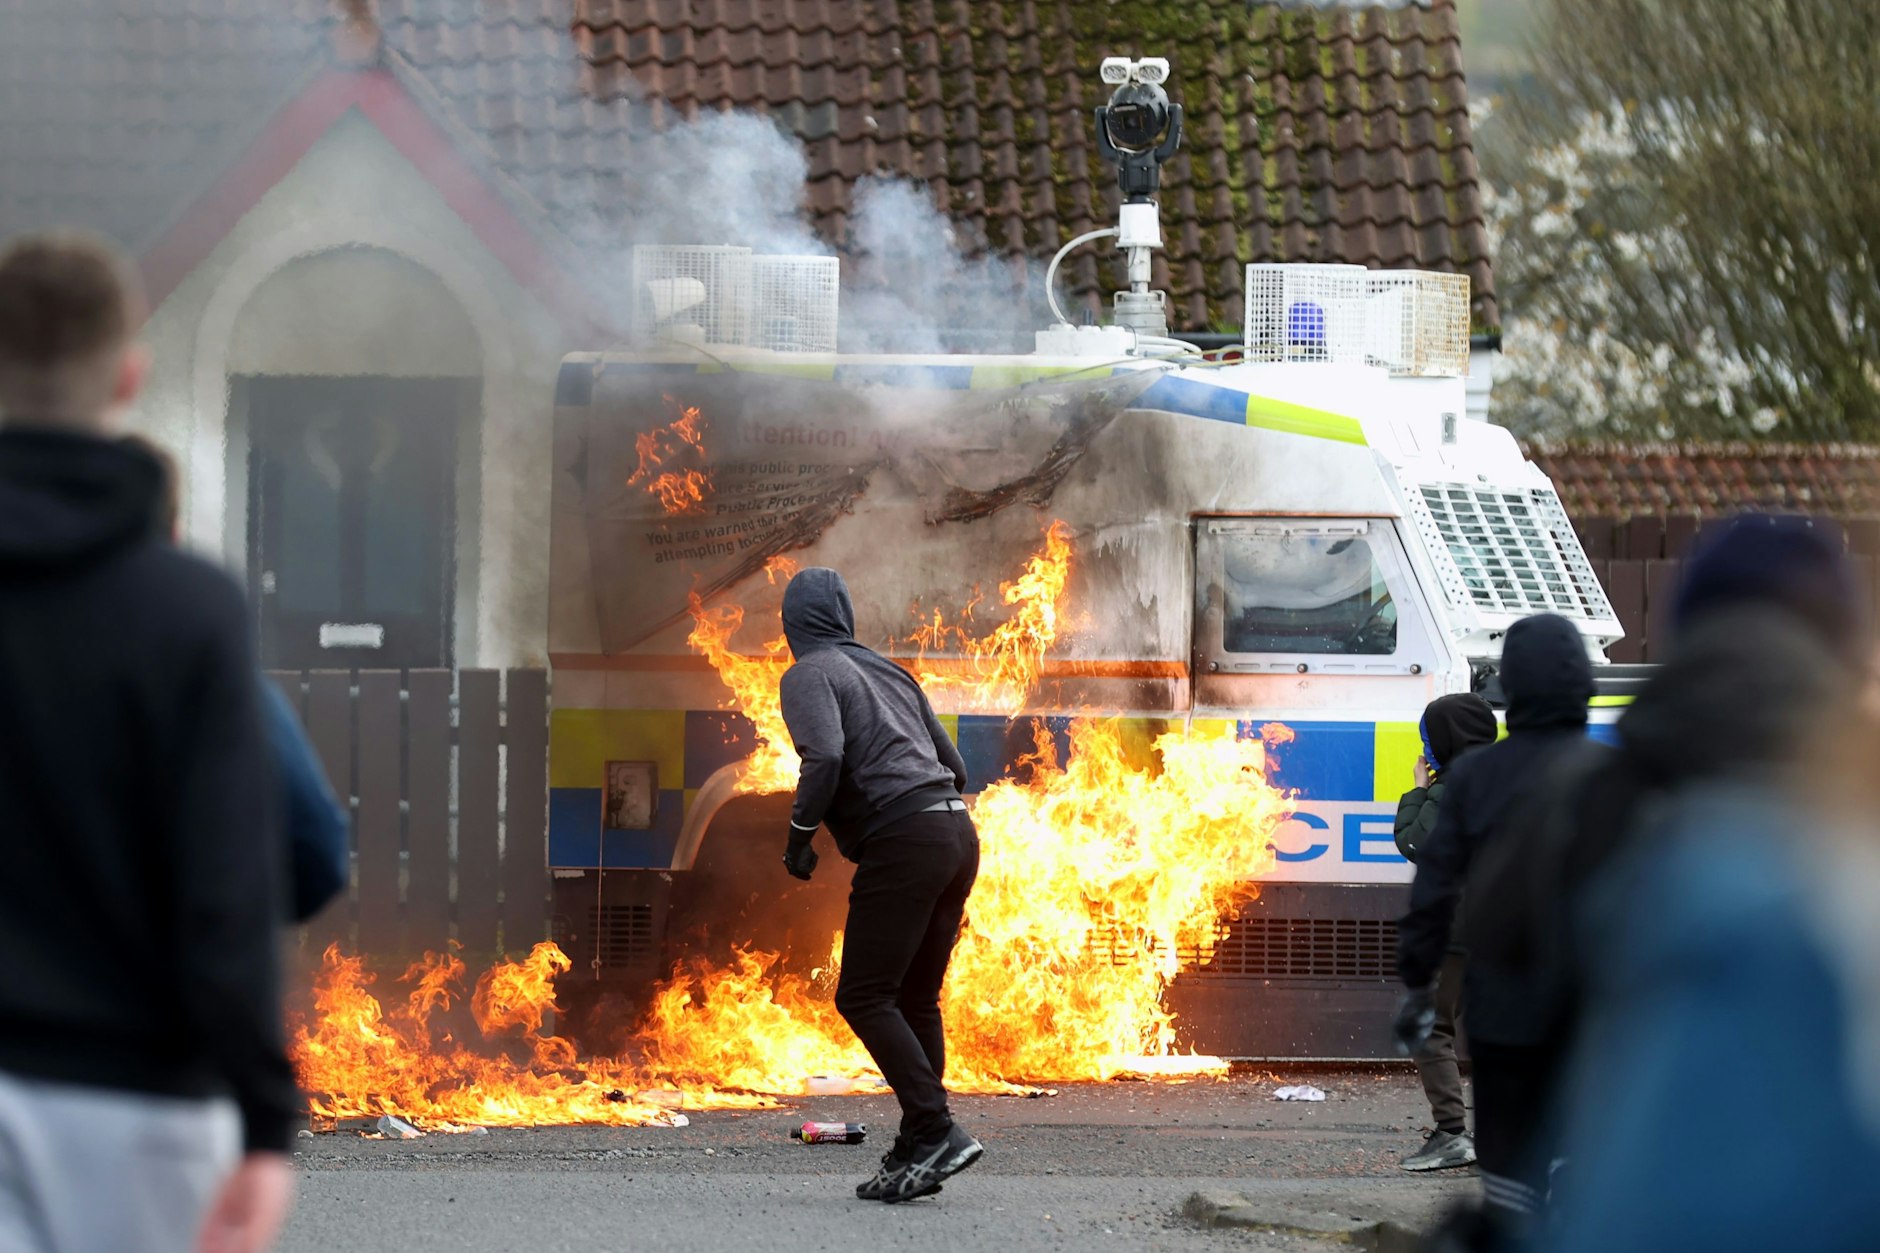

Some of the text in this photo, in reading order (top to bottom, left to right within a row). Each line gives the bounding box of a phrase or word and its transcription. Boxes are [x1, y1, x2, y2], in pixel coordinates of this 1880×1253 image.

[737, 421, 858, 448] ttention!
[750, 461, 794, 476] public
[715, 498, 765, 516] Public
[646, 531, 672, 546] You
[677, 528, 700, 543] are
[704, 520, 754, 539] warned
[757, 515, 777, 528] that
[654, 540, 735, 564] attempting
[738, 537, 751, 549] to
